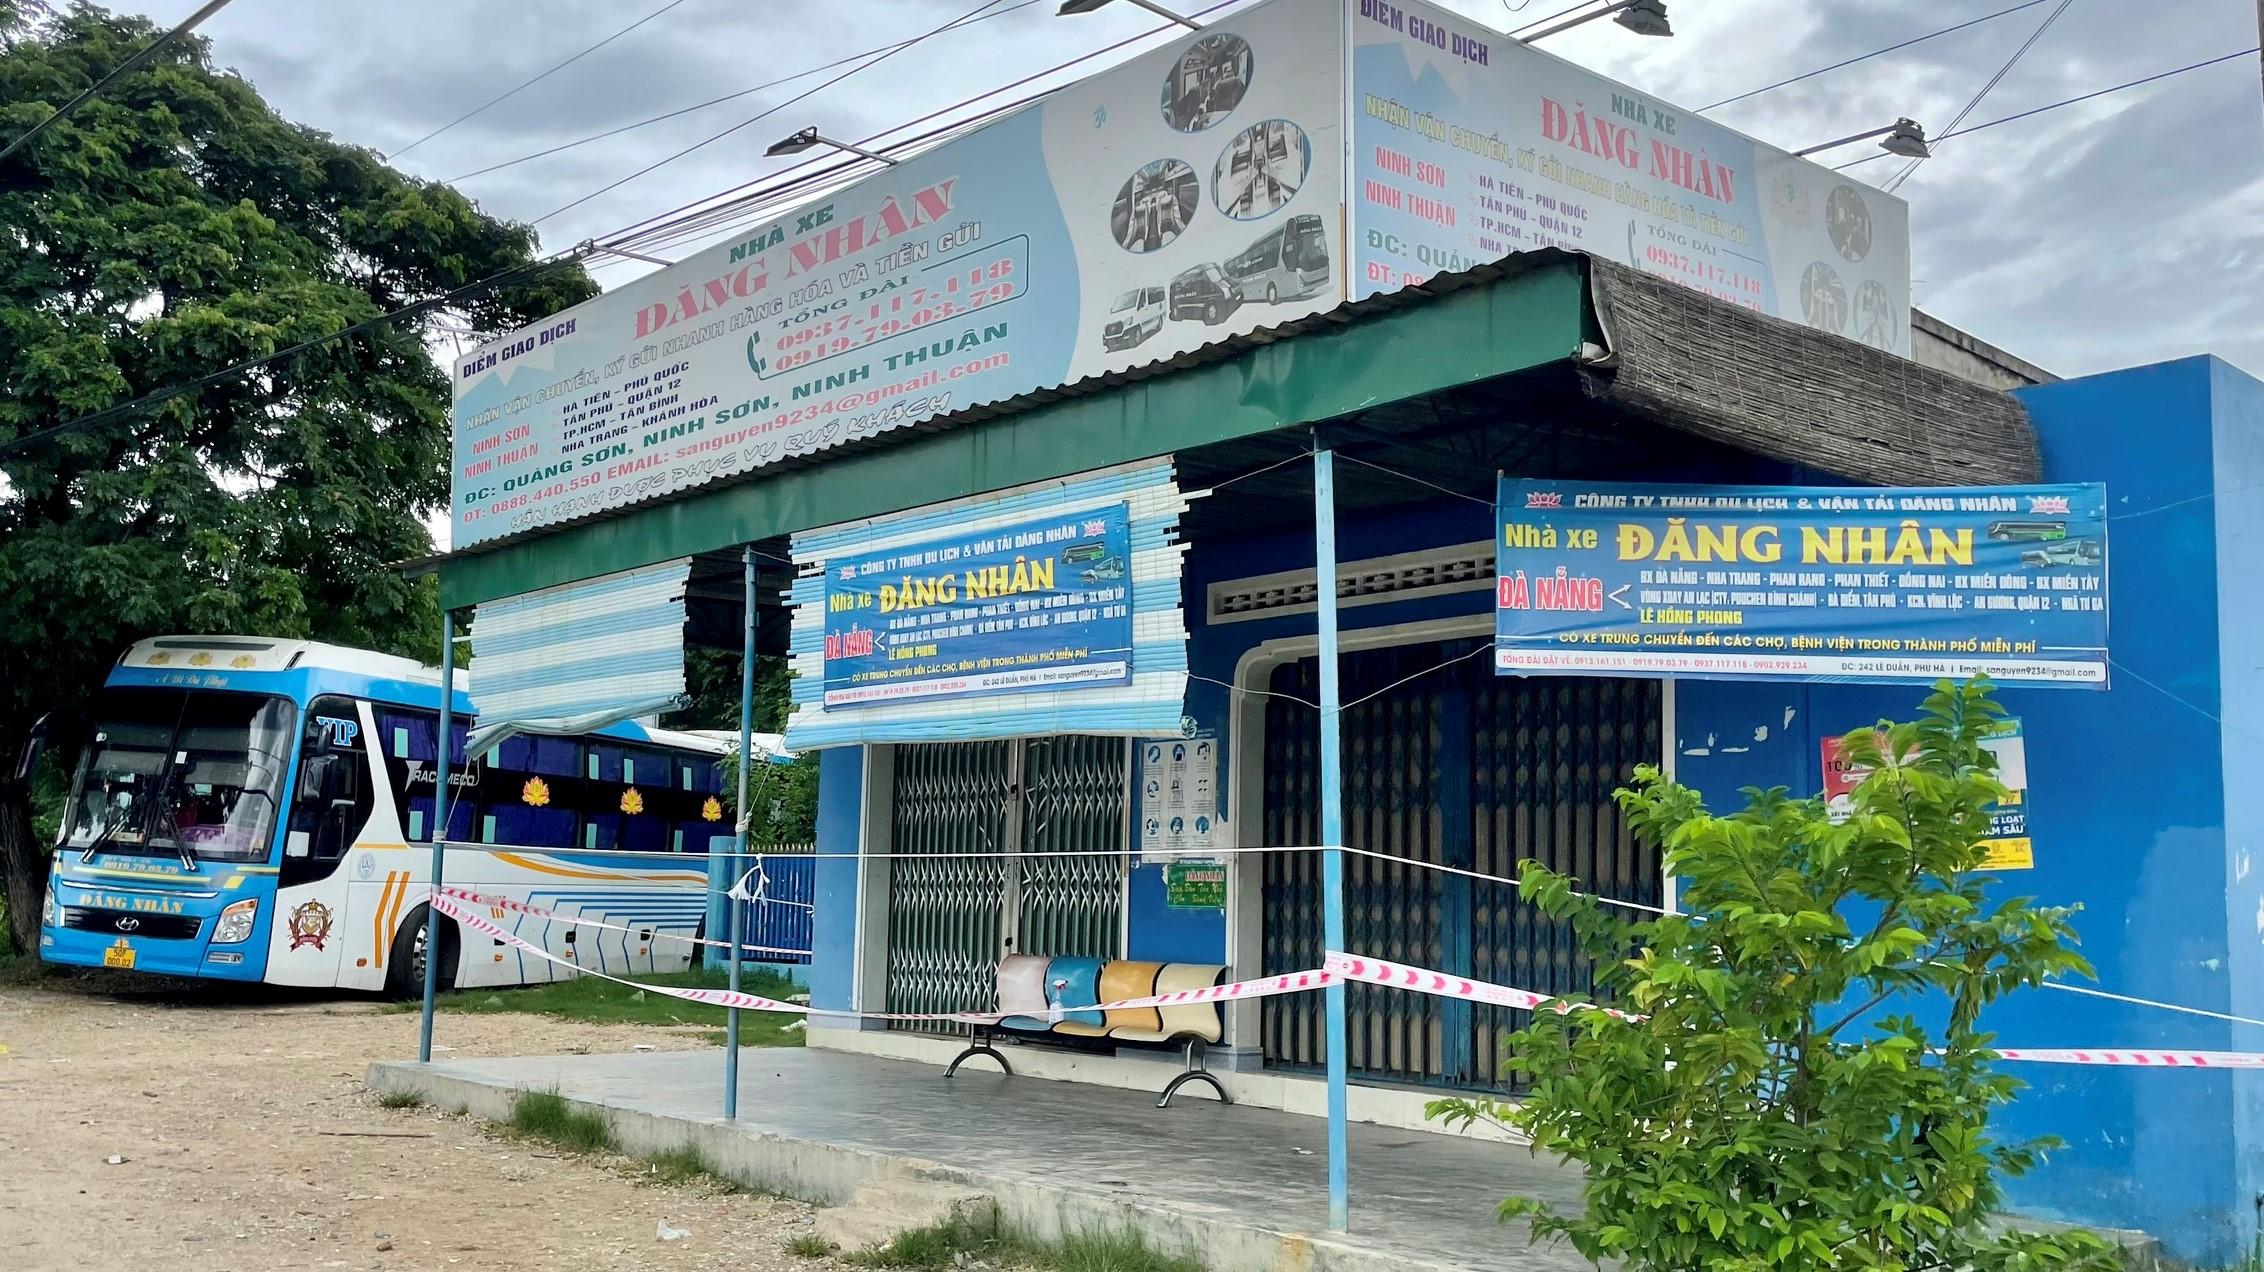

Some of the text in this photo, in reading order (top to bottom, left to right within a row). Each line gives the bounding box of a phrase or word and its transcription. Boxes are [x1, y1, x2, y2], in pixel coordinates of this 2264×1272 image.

[1409, 15, 1489, 66] GIAO DỊCH
[1365, 93, 1410, 130] NHẬN
[1611, 93, 1677, 136] NHÀ XE
[1540, 96, 1736, 204] ĐĂNG NHÂN
[1376, 147, 1445, 189] NINH SƠN
[1366, 179, 1456, 228] NINH THUẬN
[1499, 180, 1524, 200] TIÊN
[729, 204, 835, 264] NHÀ XE
[1366, 228, 1408, 257] ĐC:
[1480, 216, 1521, 240] TP.HCM
[1480, 236, 1502, 254] NHA
[1572, 225, 1583, 239] 12
[632, 176, 959, 341] ĐĂNG NHÂN
[1367, 261, 1396, 287] ĐT:
[604, 355, 625, 379] KÝ
[662, 320, 724, 355] NHANH
[730, 294, 783, 333] HÀNG
[789, 278, 833, 308] HÓA
[839, 262, 870, 290] VÀ
[777, 298, 848, 330] TỔNG
[463, 318, 576, 379] ĐIỂM GIAO DỊCH
[584, 361, 690, 407] TIÊN QUỐC
[628, 378, 682, 406] QUẬN 12
[465, 321, 1009, 504] ĐC: QUẢNG SƠN, NINH SƠN, NINH THUẬN
[561, 440, 585, 454] NHA
[589, 425, 628, 446] TRANG
[642, 405, 686, 428] KHÁNH
[563, 419, 607, 440] TP.HCM
[620, 404, 645, 421] TÂN
[464, 352, 1010, 523] ĐT: 0888.440.550 EMAIL: sanguyen9234@gmail.com
[472, 424, 530, 455] NINH SƠN
[464, 441, 540, 478] NINH THUẬN
[1575, 493, 1627, 508] CÔNG
[1632, 496, 1655, 508] TY
[1797, 497, 1813, 509] &
[1818, 496, 1860, 513] VẬN
[1864, 494, 1895, 511] TẢI
[1959, 495, 2017, 512] NHÂN
[861, 524, 1077, 576] CÔNG TY TNHH LỊCH & VẬN TẢI NHÂN
[1505, 523, 1598, 549] Nhà xe
[1616, 517, 1973, 565] ĐĂNG NHÂN
[880, 575, 957, 614] ĐĂNG
[965, 555, 1055, 601] NHÂN
[1497, 566, 1603, 611] ĐÀ NẴNG
[1707, 571, 1726, 585] NHA
[1729, 572, 1761, 586] TRANG
[1769, 572, 1796, 587] PHAN
[1834, 573, 1861, 588] PHAN
[830, 592, 872, 613] Nhà xe
[1640, 607, 1654, 624] LÊ
[1696, 610, 1743, 625] PHONG
[825, 628, 841, 660] ĐÀ
[843, 622, 873, 658] NẴNG
[1559, 630, 1579, 643] CÓ
[1582, 633, 1597, 644] XE
[1600, 633, 1640, 645] TRUNG
[1644, 630, 1692, 645] CHUYỂN
[1696, 632, 1720, 646] ĐẾN
[1723, 634, 1752, 647] CÁC
[1755, 636, 1788, 650] CHỢ,
[1791, 634, 1823, 651] BỆNH
[1827, 636, 1855, 652] VIỆN
[1857, 639, 1900, 651] TRONG
[1904, 637, 1946, 651] THÀNH
[1950, 637, 1977, 652] PHỐ
[2015, 639, 2036, 654] PHÍ
[926, 662, 940, 674] CÁC
[992, 655, 1015, 667] TRONG
[1040, 649, 1055, 662] PHỐ
[1859, 662, 1874, 671] 242
[316, 716, 358, 747] VIP
[405, 760, 476, 793] TRACMECO
[2001, 815, 2025, 828] LOẠT
[2003, 822, 2024, 835] SÂU
